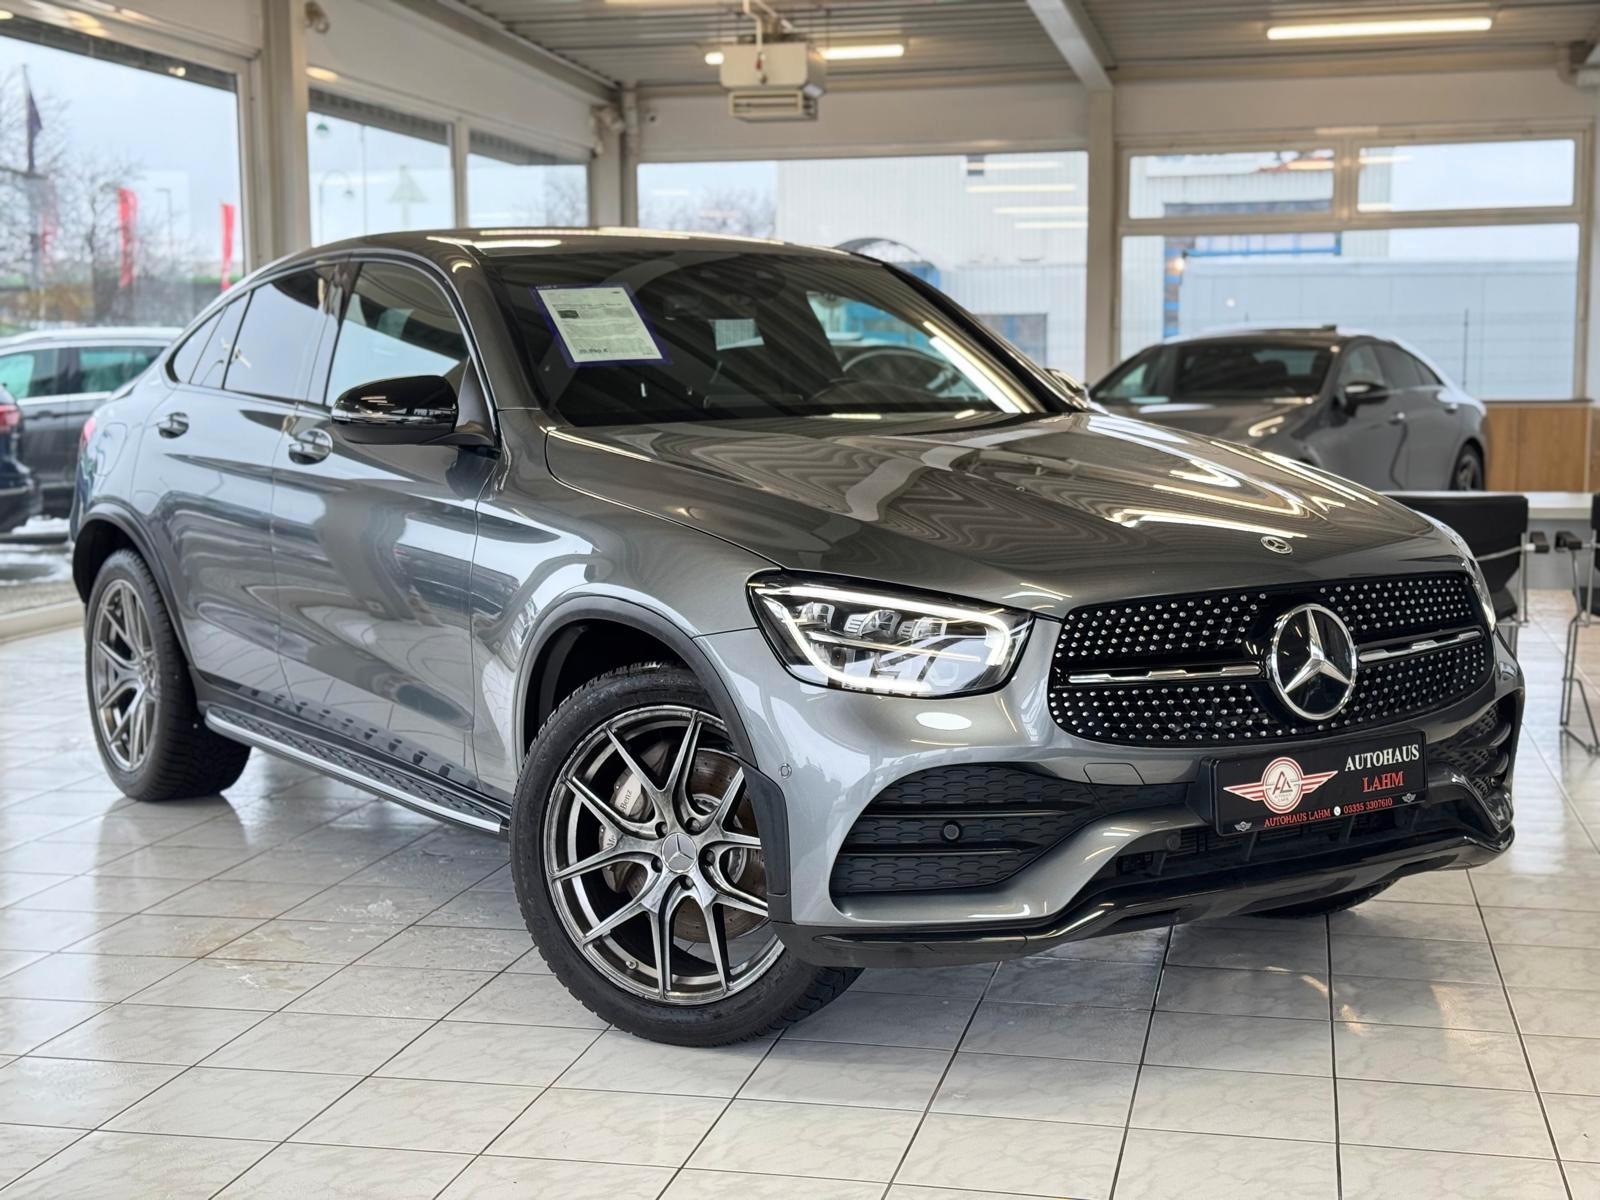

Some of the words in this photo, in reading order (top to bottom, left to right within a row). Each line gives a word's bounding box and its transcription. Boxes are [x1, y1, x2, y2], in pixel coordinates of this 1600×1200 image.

[1344, 743, 1420, 772] AUTOHAUS
[1362, 770, 1404, 793] LAHM
[1263, 812, 1308, 828] AUTOHAUS
[1308, 808, 1331, 820] LAHM
[1343, 802, 1365, 814] 03335
[1365, 797, 1393, 810] 3307610
